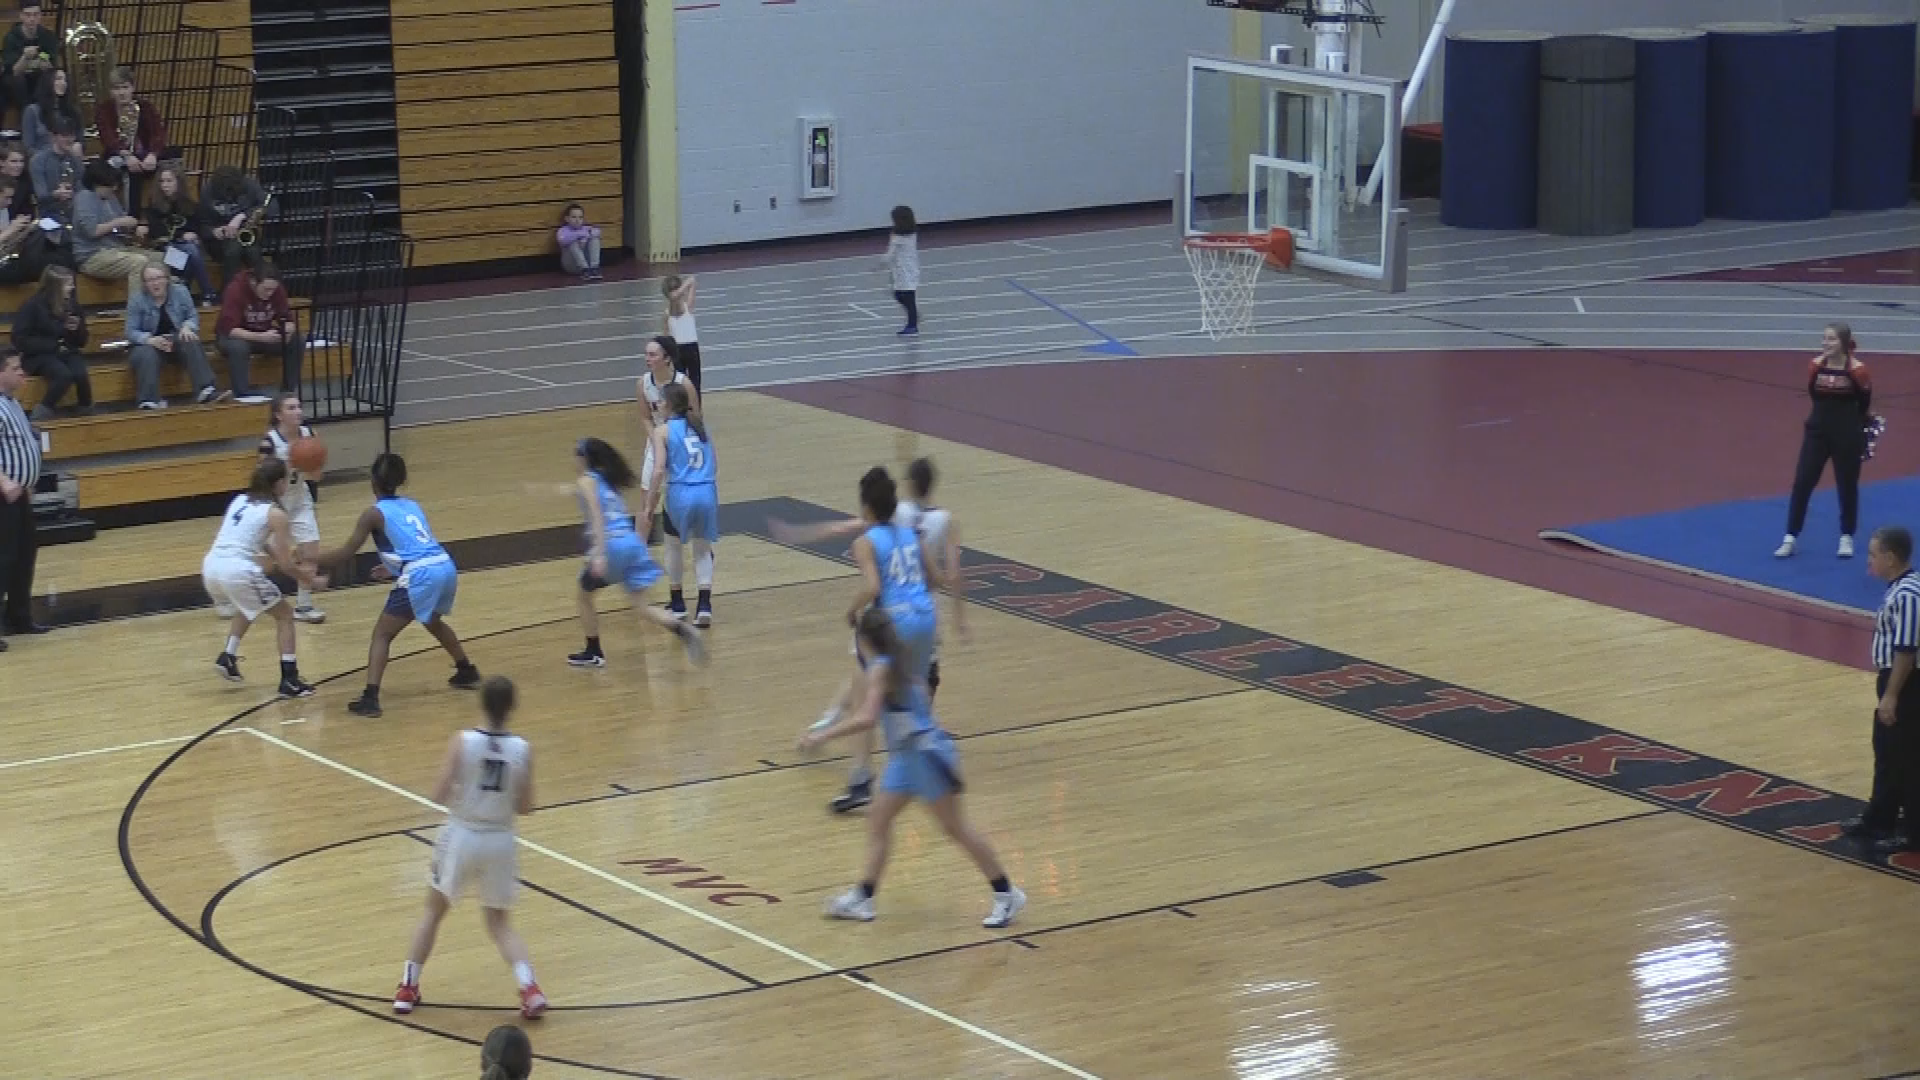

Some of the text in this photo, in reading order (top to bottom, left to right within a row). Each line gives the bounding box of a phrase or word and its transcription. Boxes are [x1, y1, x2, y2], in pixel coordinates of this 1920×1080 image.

[684, 436, 704, 469] 5
[405, 513, 431, 544] 3
[889, 543, 922, 587] 45
[841, 545, 1521, 721] CARLET
[616, 857, 783, 906] MVC
